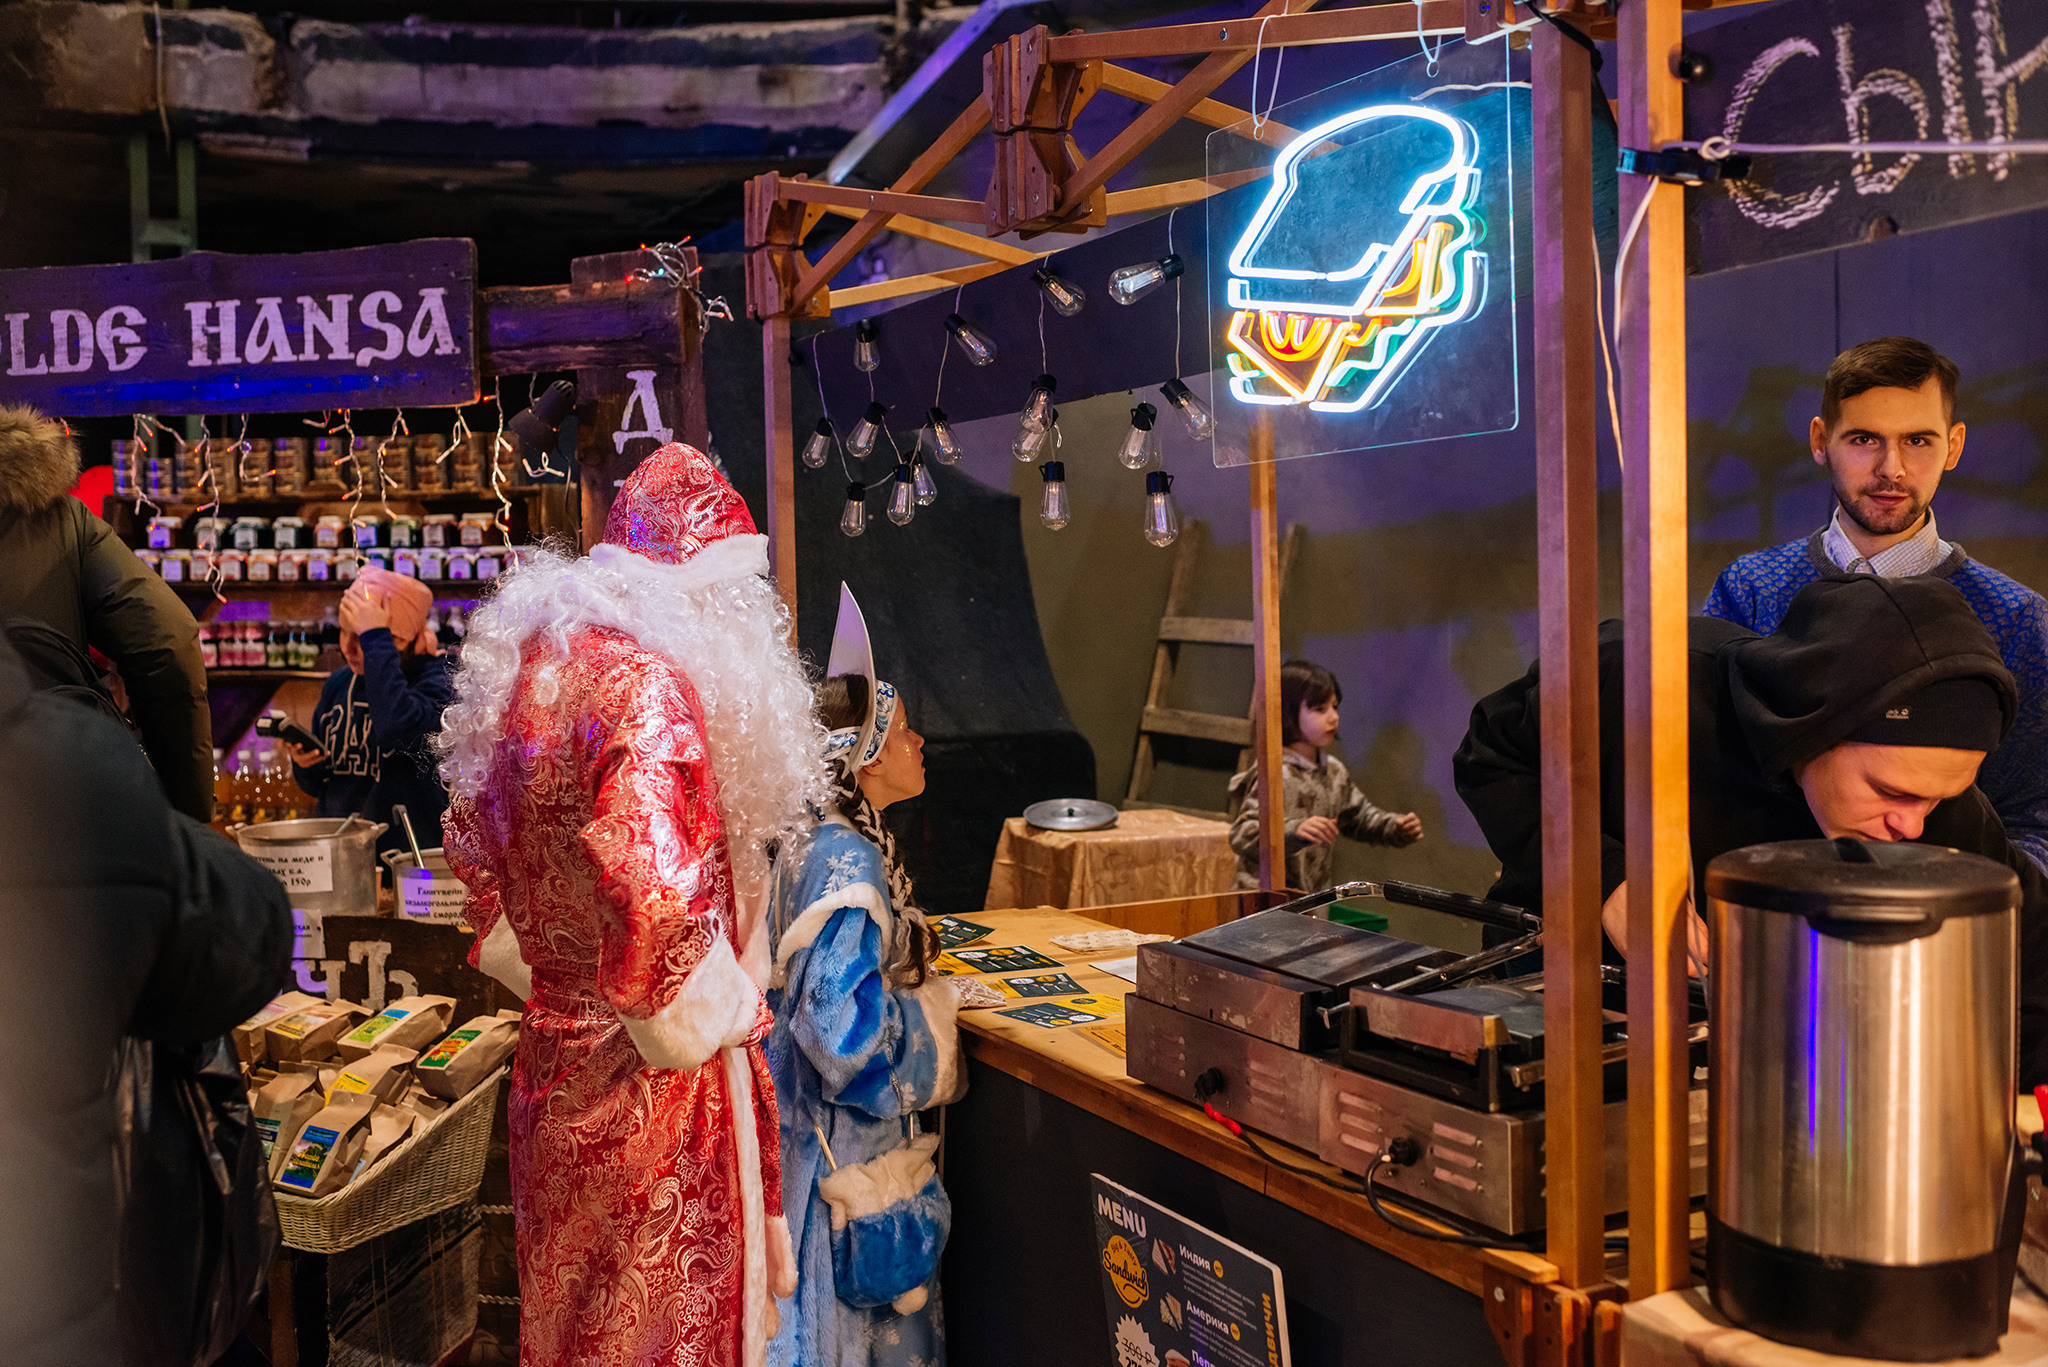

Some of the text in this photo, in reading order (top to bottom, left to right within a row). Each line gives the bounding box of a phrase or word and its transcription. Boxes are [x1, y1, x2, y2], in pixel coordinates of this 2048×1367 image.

[0, 288, 462, 377] LDE HANSA
[1097, 1193, 1147, 1238] MENU
[1104, 1250, 1148, 1294] Sandwich
[1179, 1244, 1211, 1271] Индия
[1186, 1299, 1230, 1335] Америка
